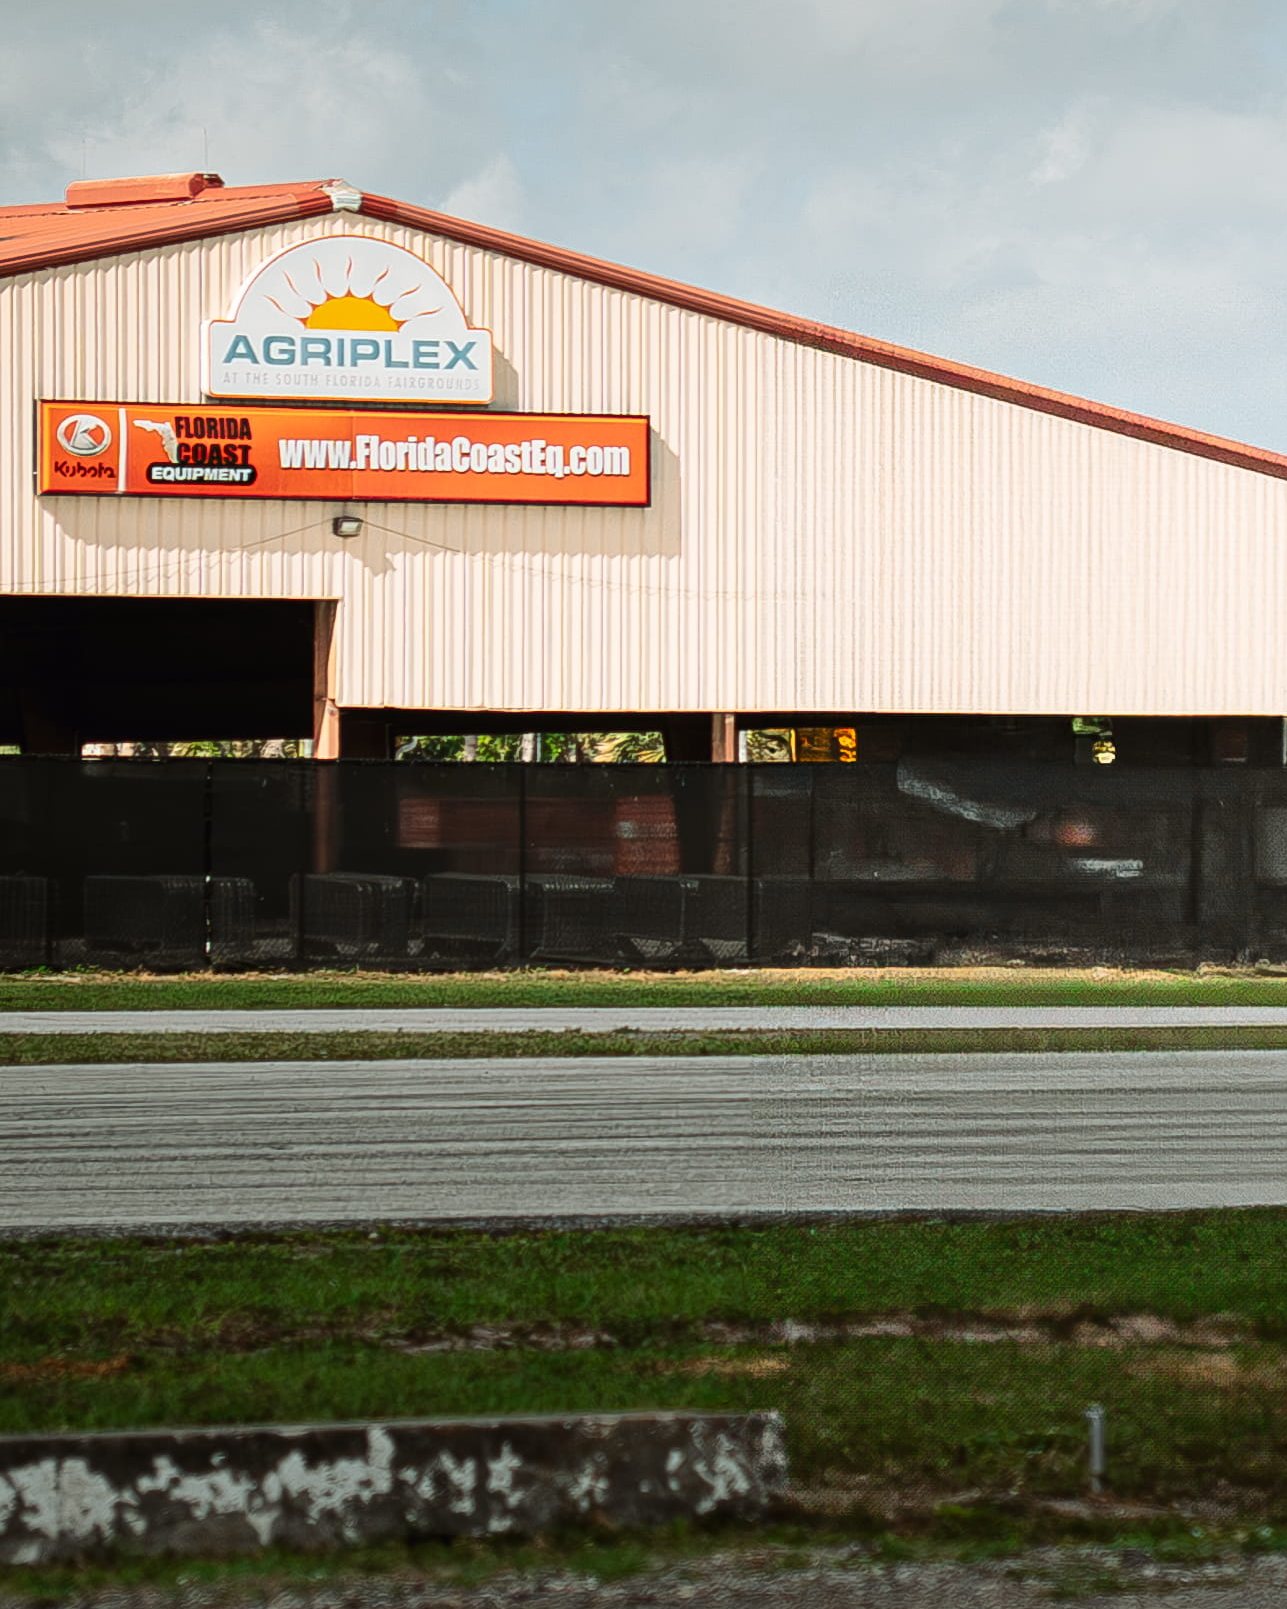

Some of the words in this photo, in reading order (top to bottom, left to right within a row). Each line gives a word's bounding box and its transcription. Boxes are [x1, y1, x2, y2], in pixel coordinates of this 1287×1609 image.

[222, 334, 479, 371] AGRIPLEX
[222, 371, 238, 385] AT
[245, 372, 269, 386] THE
[275, 373, 319, 387] SOUTH
[325, 374, 382, 388] FLORIDA
[388, 376, 480, 391] FAIRGROUNDS
[174, 416, 253, 441] FLORIDA
[176, 442, 253, 465] COAST
[278, 434, 631, 479] www.FloridaCoastEq.com
[54, 460, 116, 479] Kubota
[151, 466, 253, 482] EQUIPMENT
